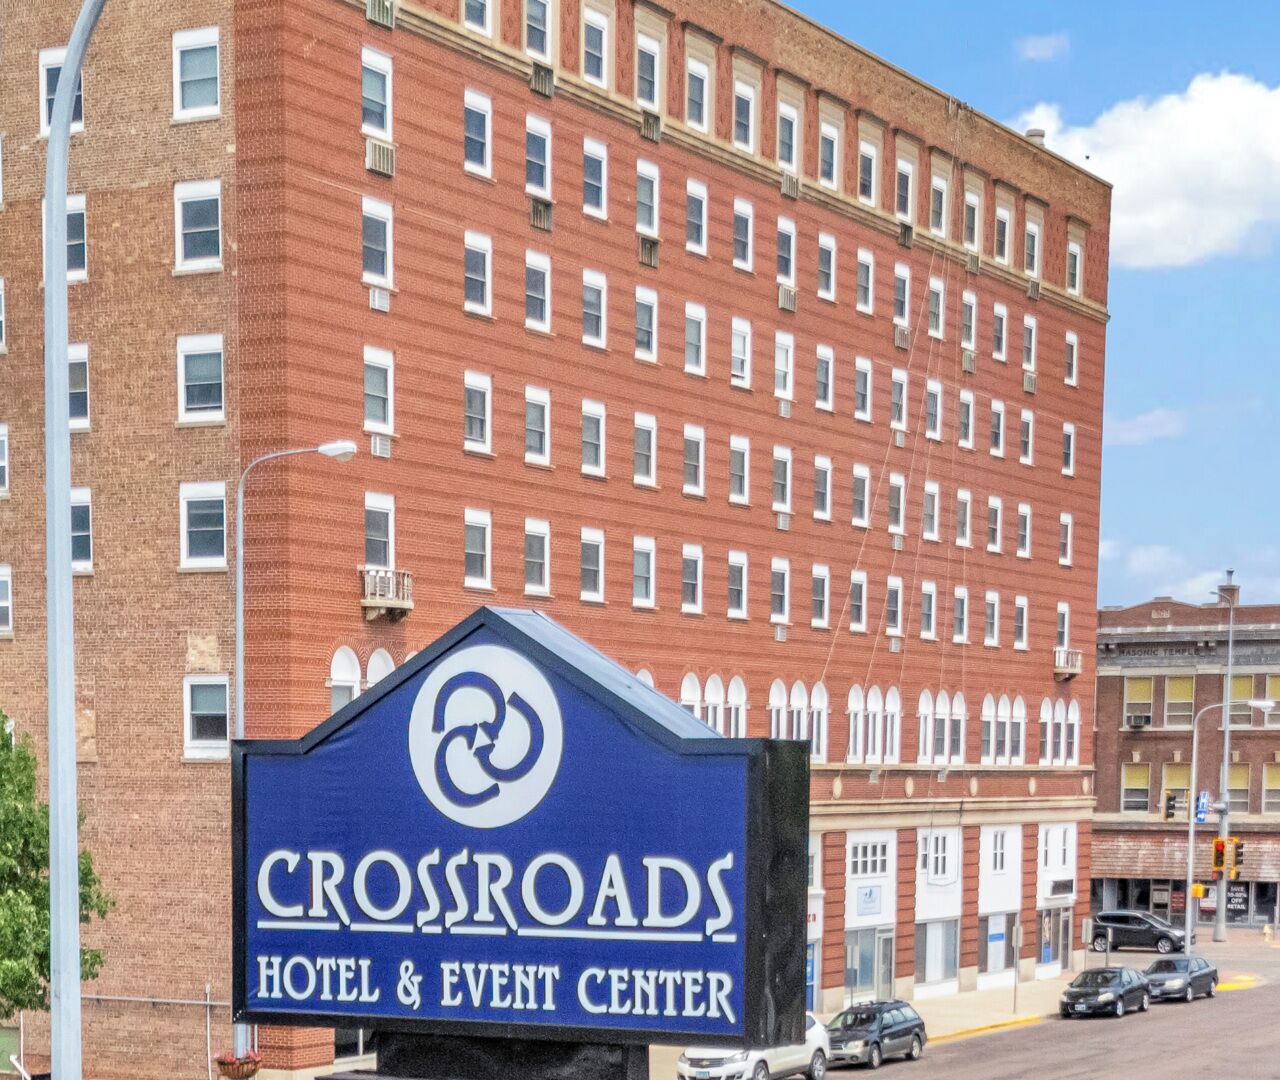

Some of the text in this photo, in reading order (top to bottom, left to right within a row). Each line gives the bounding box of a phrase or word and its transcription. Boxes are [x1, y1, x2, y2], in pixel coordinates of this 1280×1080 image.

[1119, 647, 1200, 657] MASONIC TEMPLE
[256, 847, 735, 936] CROSSROADS
[257, 955, 737, 1024] HOTEL & EVENT CENTER
